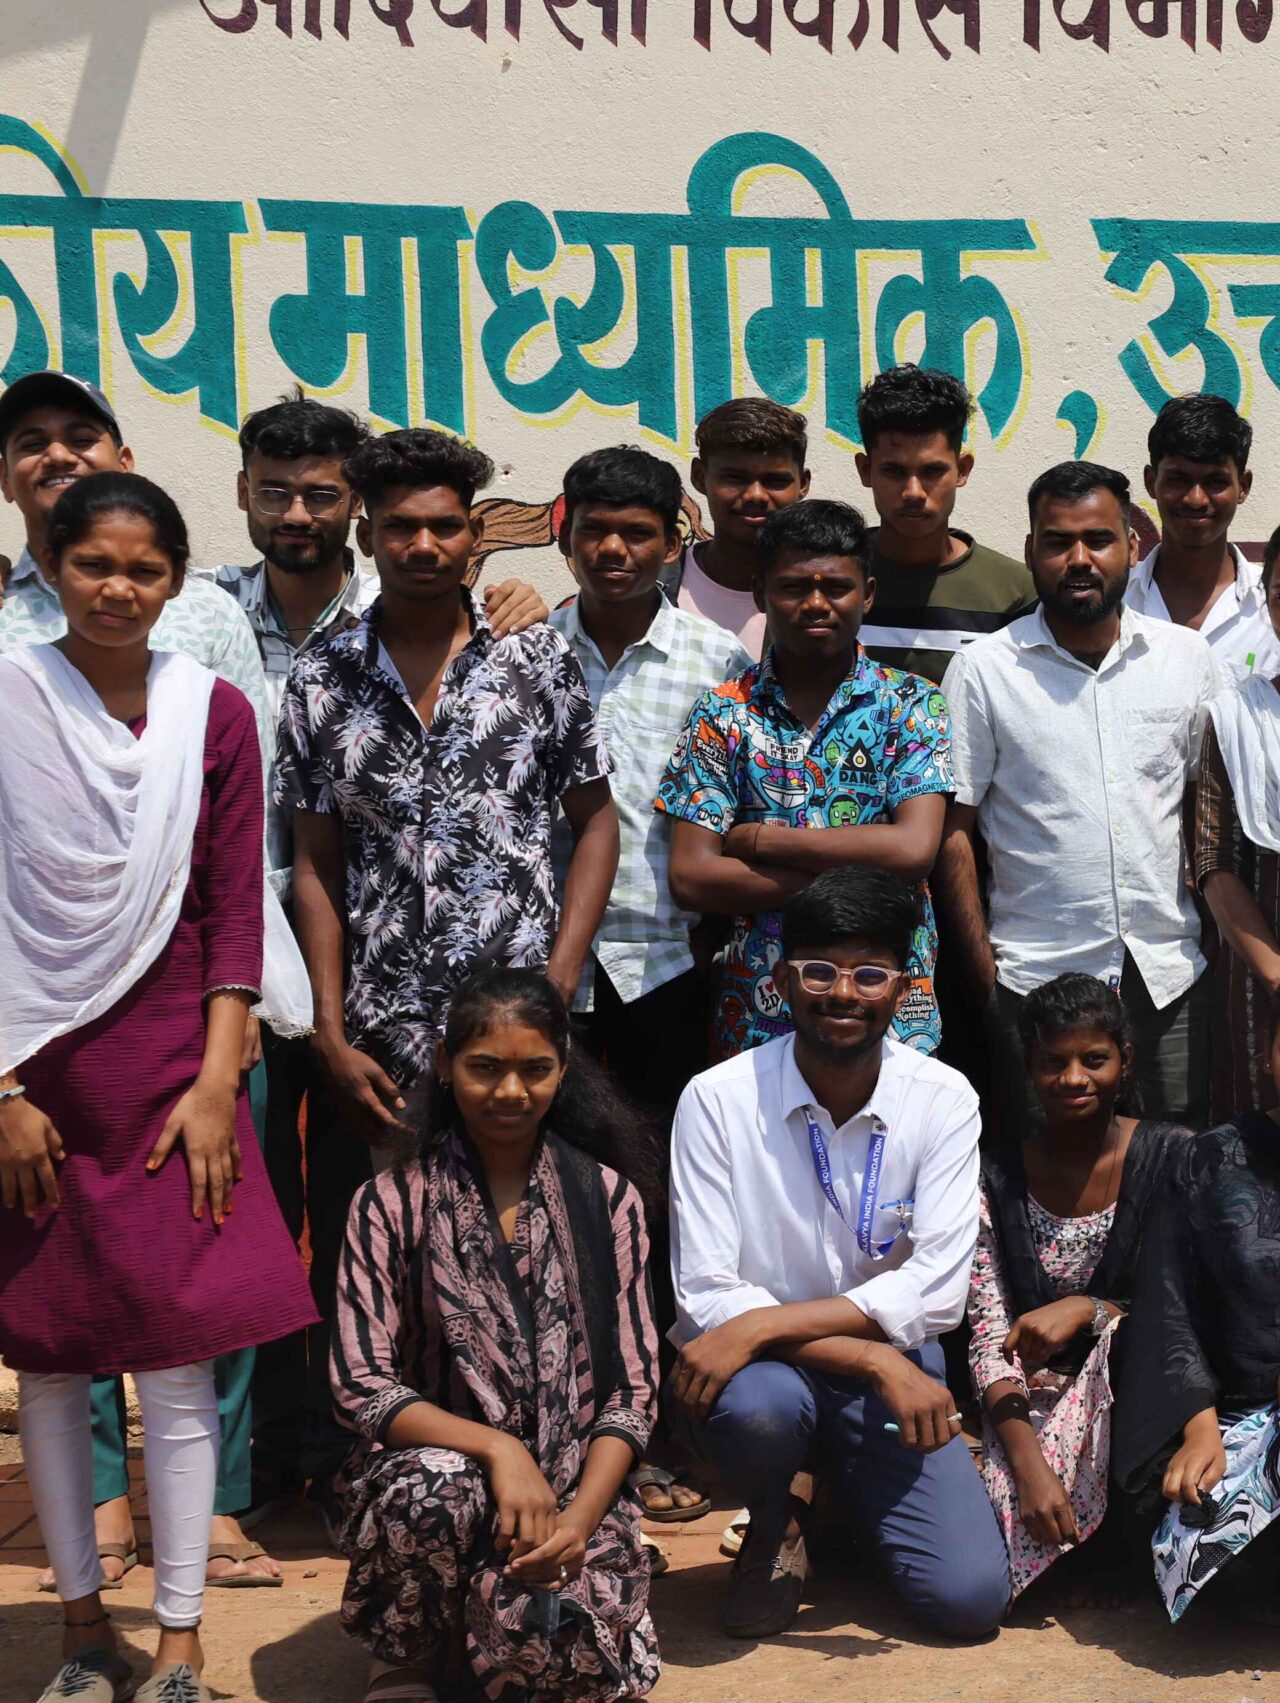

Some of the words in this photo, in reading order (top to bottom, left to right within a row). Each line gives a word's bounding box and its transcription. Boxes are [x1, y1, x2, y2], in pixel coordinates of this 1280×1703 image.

[839, 771, 877, 786] DANG
[813, 1127, 831, 1184] FOUNDATION
[867, 1137, 884, 1193] FOUNDATION
[863, 1195, 874, 1220] INDIA
